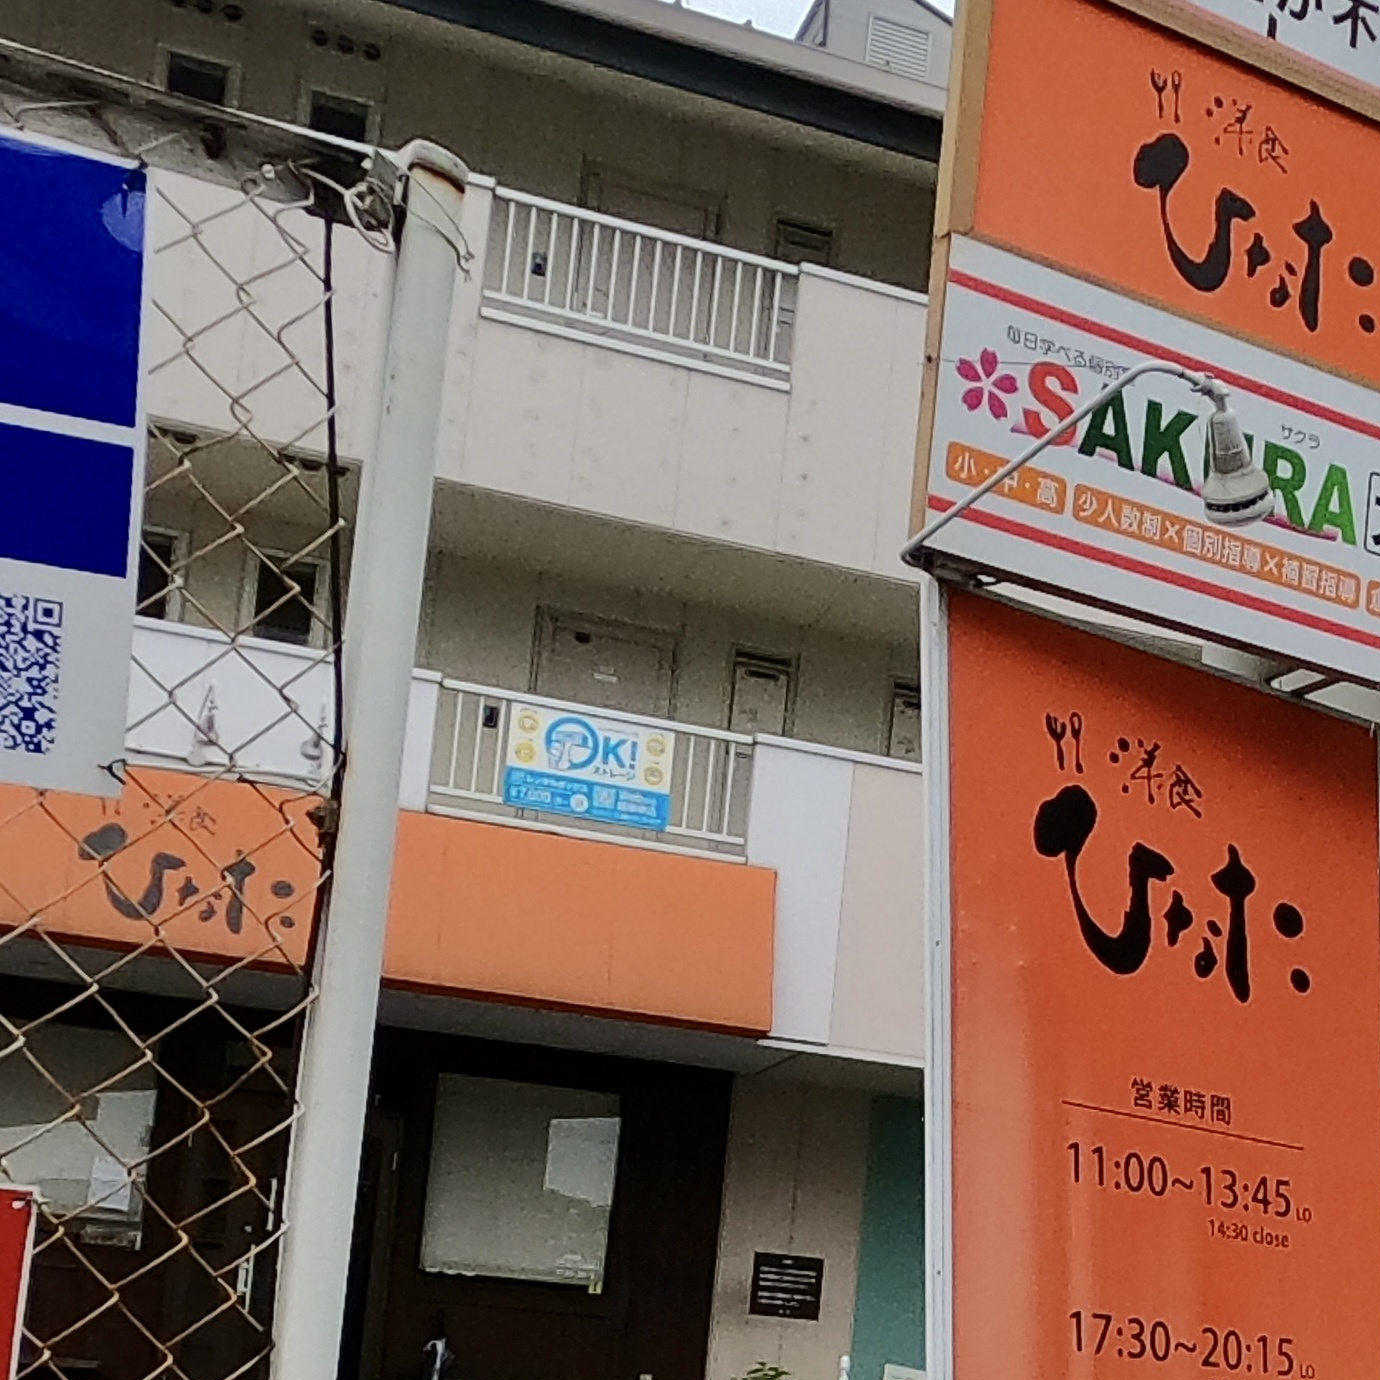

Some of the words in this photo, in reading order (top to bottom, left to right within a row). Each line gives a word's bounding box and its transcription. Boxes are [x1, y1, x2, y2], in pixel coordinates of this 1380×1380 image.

[1021, 361, 1357, 546] SAKRA
[1281, 425, 1321, 449] サクラ
[1109, 737, 1203, 818] 洋食
[1034, 785, 1310, 1003] ひなた
[1131, 1078, 1233, 1126] 営業時間
[1208, 1219, 1248, 1241] 14:30
[1253, 1226, 1289, 1248] close
